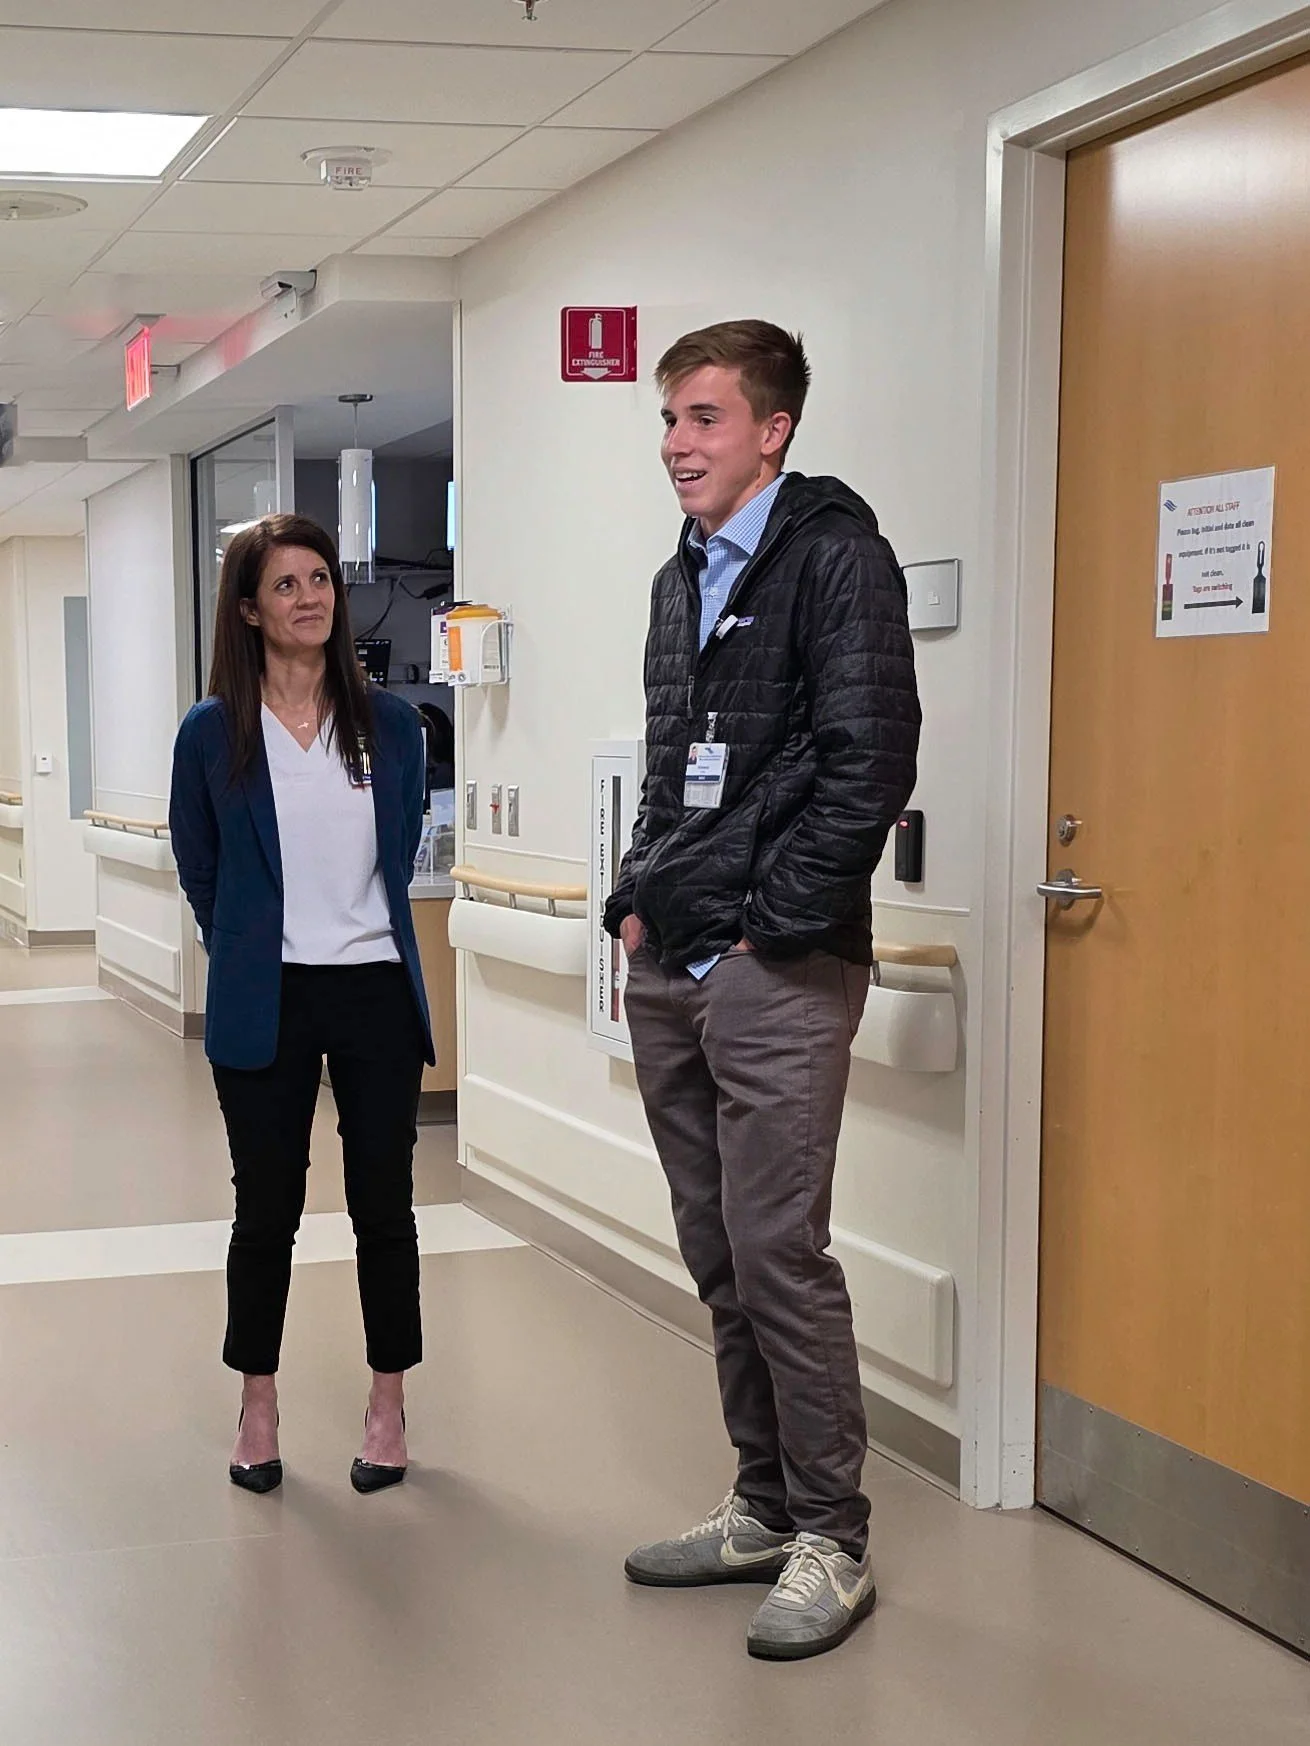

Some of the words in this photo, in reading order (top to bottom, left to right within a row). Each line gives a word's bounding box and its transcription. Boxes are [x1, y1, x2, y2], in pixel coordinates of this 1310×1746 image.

[335, 167, 363, 175] FIRE
[571, 359, 620, 367] EXTINGUISHER
[1188, 505, 1214, 515] ATTENTION
[1215, 503, 1224, 513] ALL
[1225, 501, 1240, 511] STAFF
[1214, 522, 1224, 532] and
[1224, 521, 1235, 531] date
[1242, 520, 1254, 528] clean
